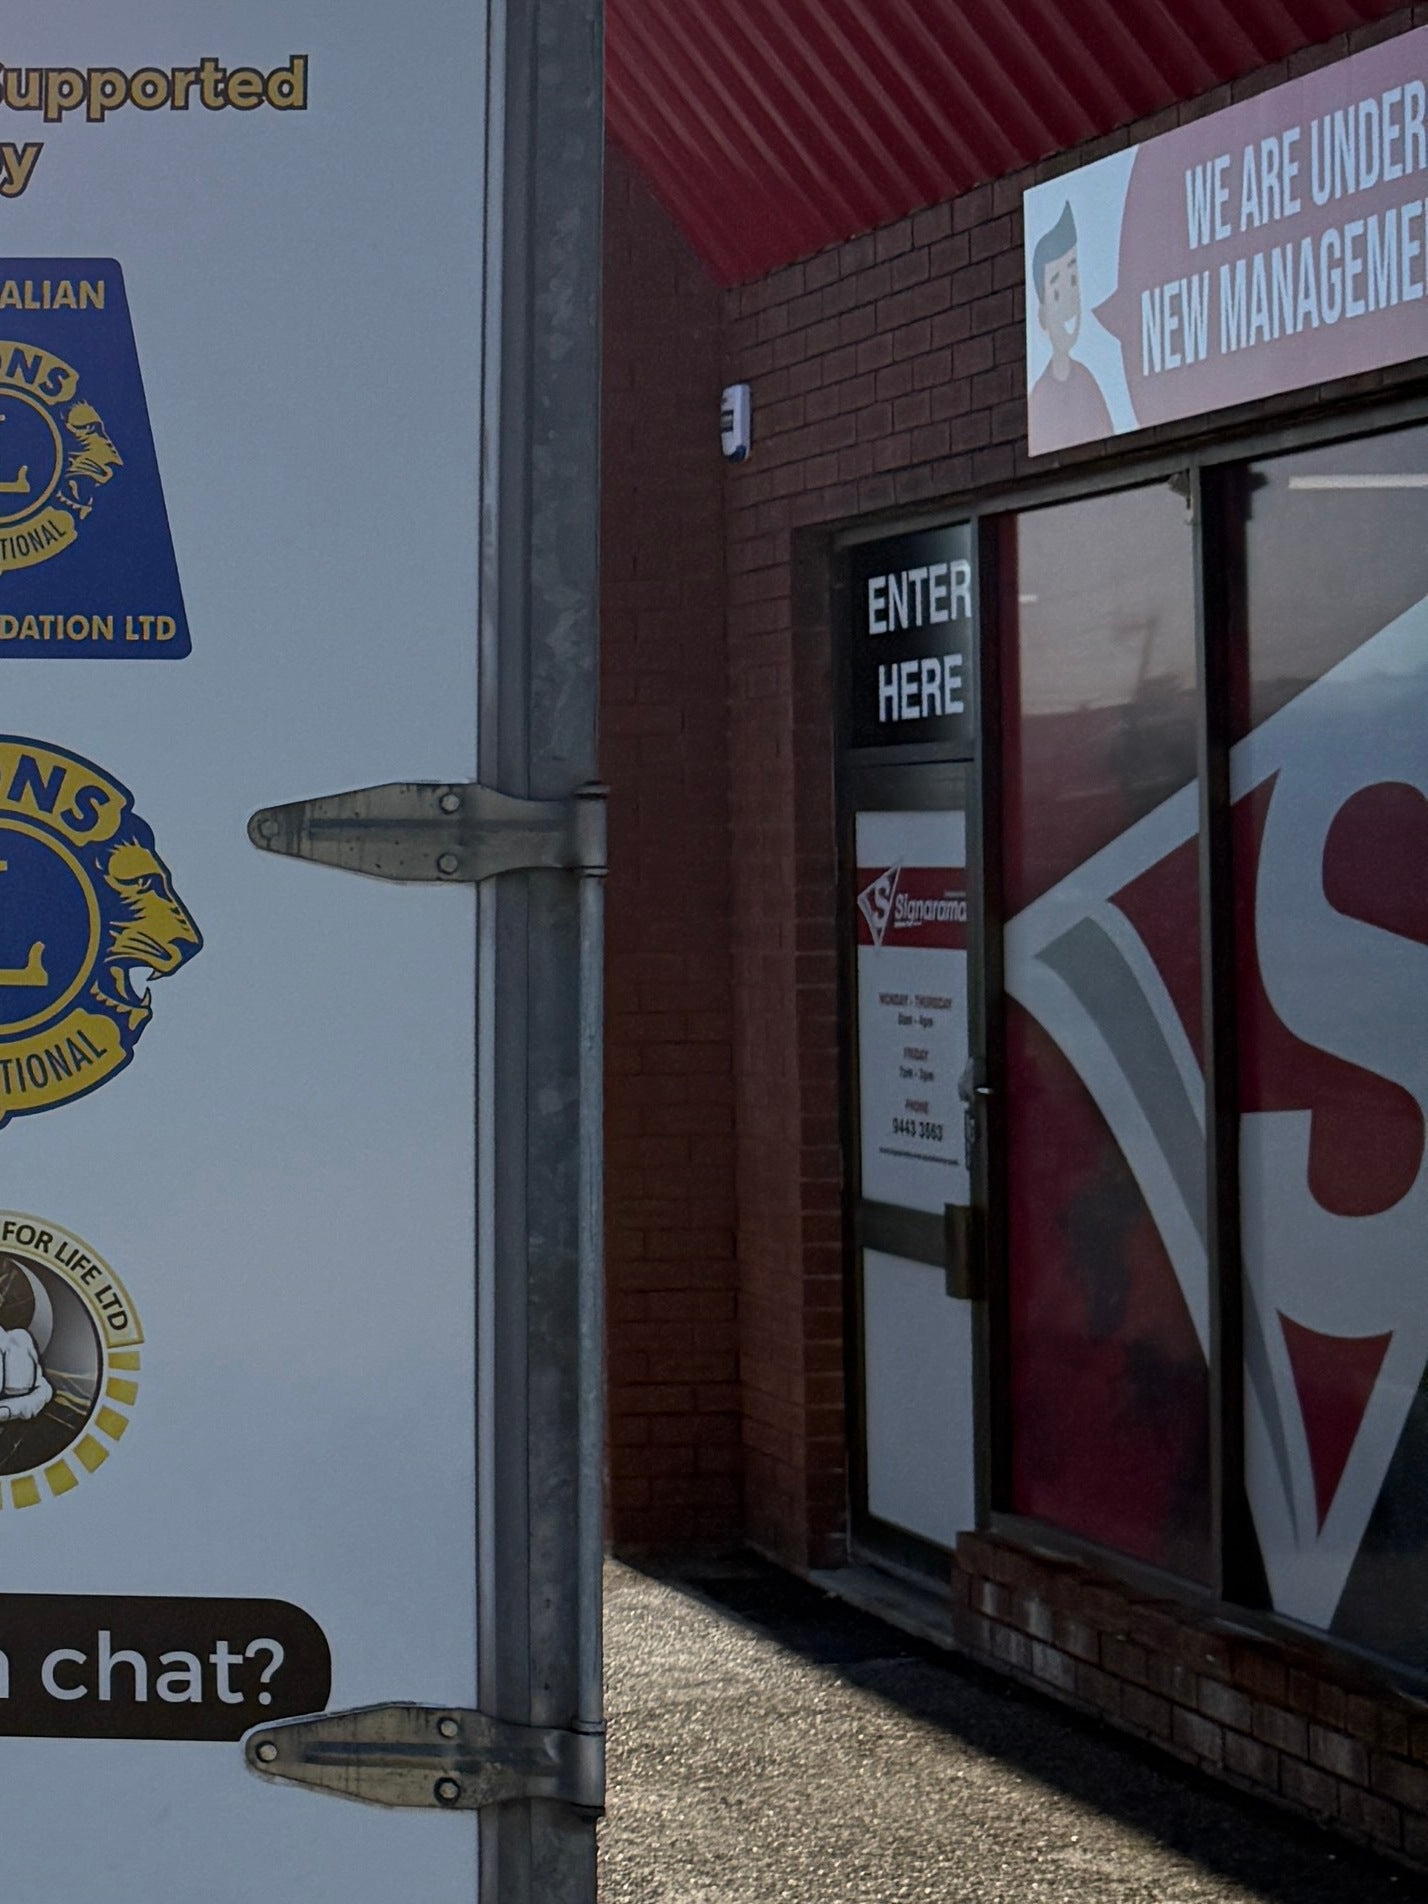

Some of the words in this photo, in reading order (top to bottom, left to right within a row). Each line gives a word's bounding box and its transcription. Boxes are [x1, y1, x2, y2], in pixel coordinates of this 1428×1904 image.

[1185, 153, 1232, 249] WE
[1240, 126, 1301, 232] ARE
[1310, 79, 1428, 206] UNDER
[1141, 271, 1210, 376] NEW
[1219, 197, 1428, 354] MANAGEME
[125, 615, 176, 641] LTD
[868, 558, 972, 635] ENTER
[878, 653, 964, 723] HERE
[895, 893, 966, 922] Signarama
[2, 1221, 54, 1254] FOR
[54, 1242, 102, 1286] LIFE
[94, 1284, 129, 1332] LTD
[41, 1630, 285, 1706] chat?
